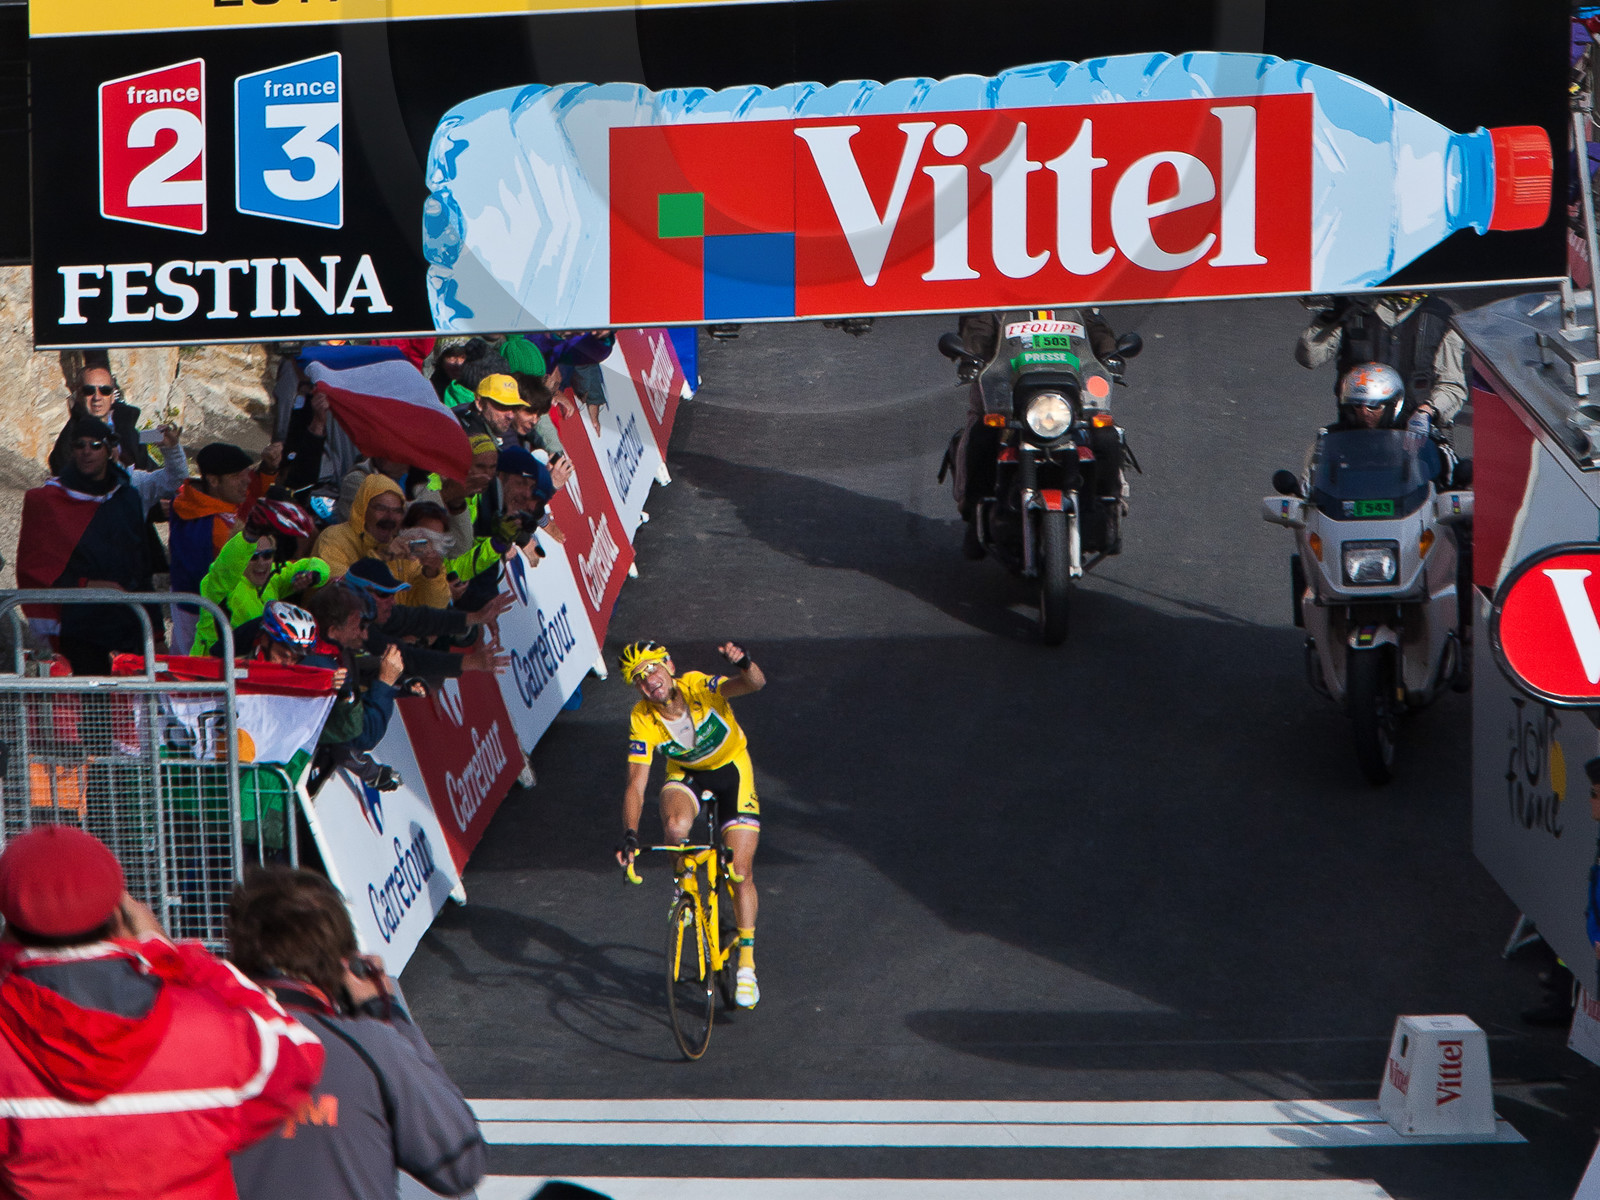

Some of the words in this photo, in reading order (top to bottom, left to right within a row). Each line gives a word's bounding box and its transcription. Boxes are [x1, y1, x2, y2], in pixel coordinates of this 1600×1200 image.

[126, 84, 200, 104] france
[264, 78, 337, 98] france
[126, 108, 205, 208] 2
[262, 103, 342, 201] 3
[794, 106, 1268, 287] Vittel
[57, 254, 393, 325] FESTINA
[1024, 352, 1068, 362] PRESSE
[1043, 337, 1068, 347] 503
[510, 603, 577, 709] Carrefour
[445, 719, 508, 833] Carrefour
[368, 829, 437, 944] Carrefour
[1436, 1039, 1464, 1107] Vittel
